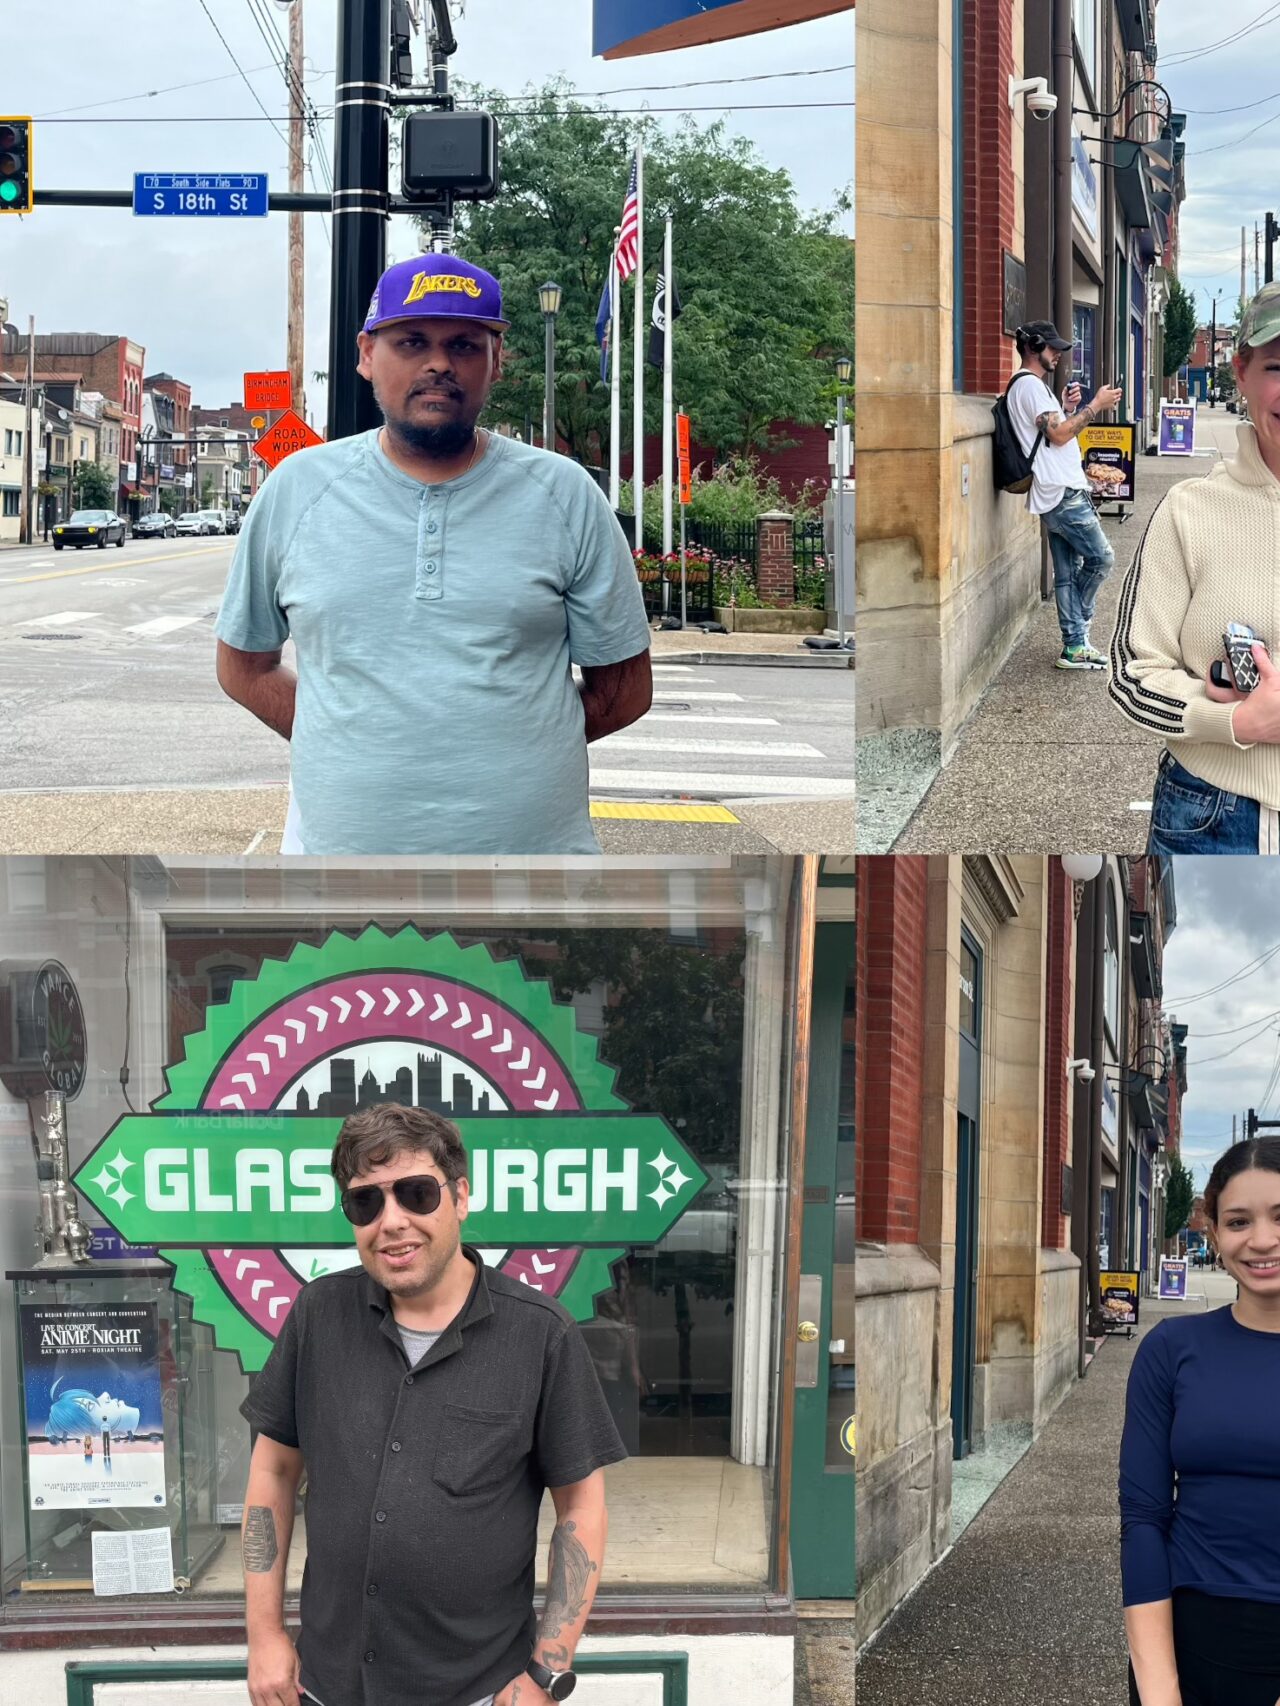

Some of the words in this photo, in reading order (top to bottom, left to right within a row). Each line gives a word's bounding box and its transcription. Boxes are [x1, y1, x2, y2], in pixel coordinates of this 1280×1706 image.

[150, 178, 159, 187] 70
[172, 178, 189, 187] South
[195, 178, 209, 187] Side
[215, 179, 230, 188] Flats
[242, 179, 252, 187] 90
[153, 192, 165, 210] S
[178, 193, 216, 210] 18th
[229, 193, 248, 210] St
[402, 271, 482, 305] LAKERS
[247, 380, 288, 389] BIRMINGHAM
[255, 393, 280, 402] BRIDGE
[274, 429, 306, 439] ROAD
[272, 442, 308, 452] WORK
[65, 1323, 96, 1331] CONCERT
[40, 1330, 90, 1345] ANIME
[92, 1329, 141, 1344] NIGHT
